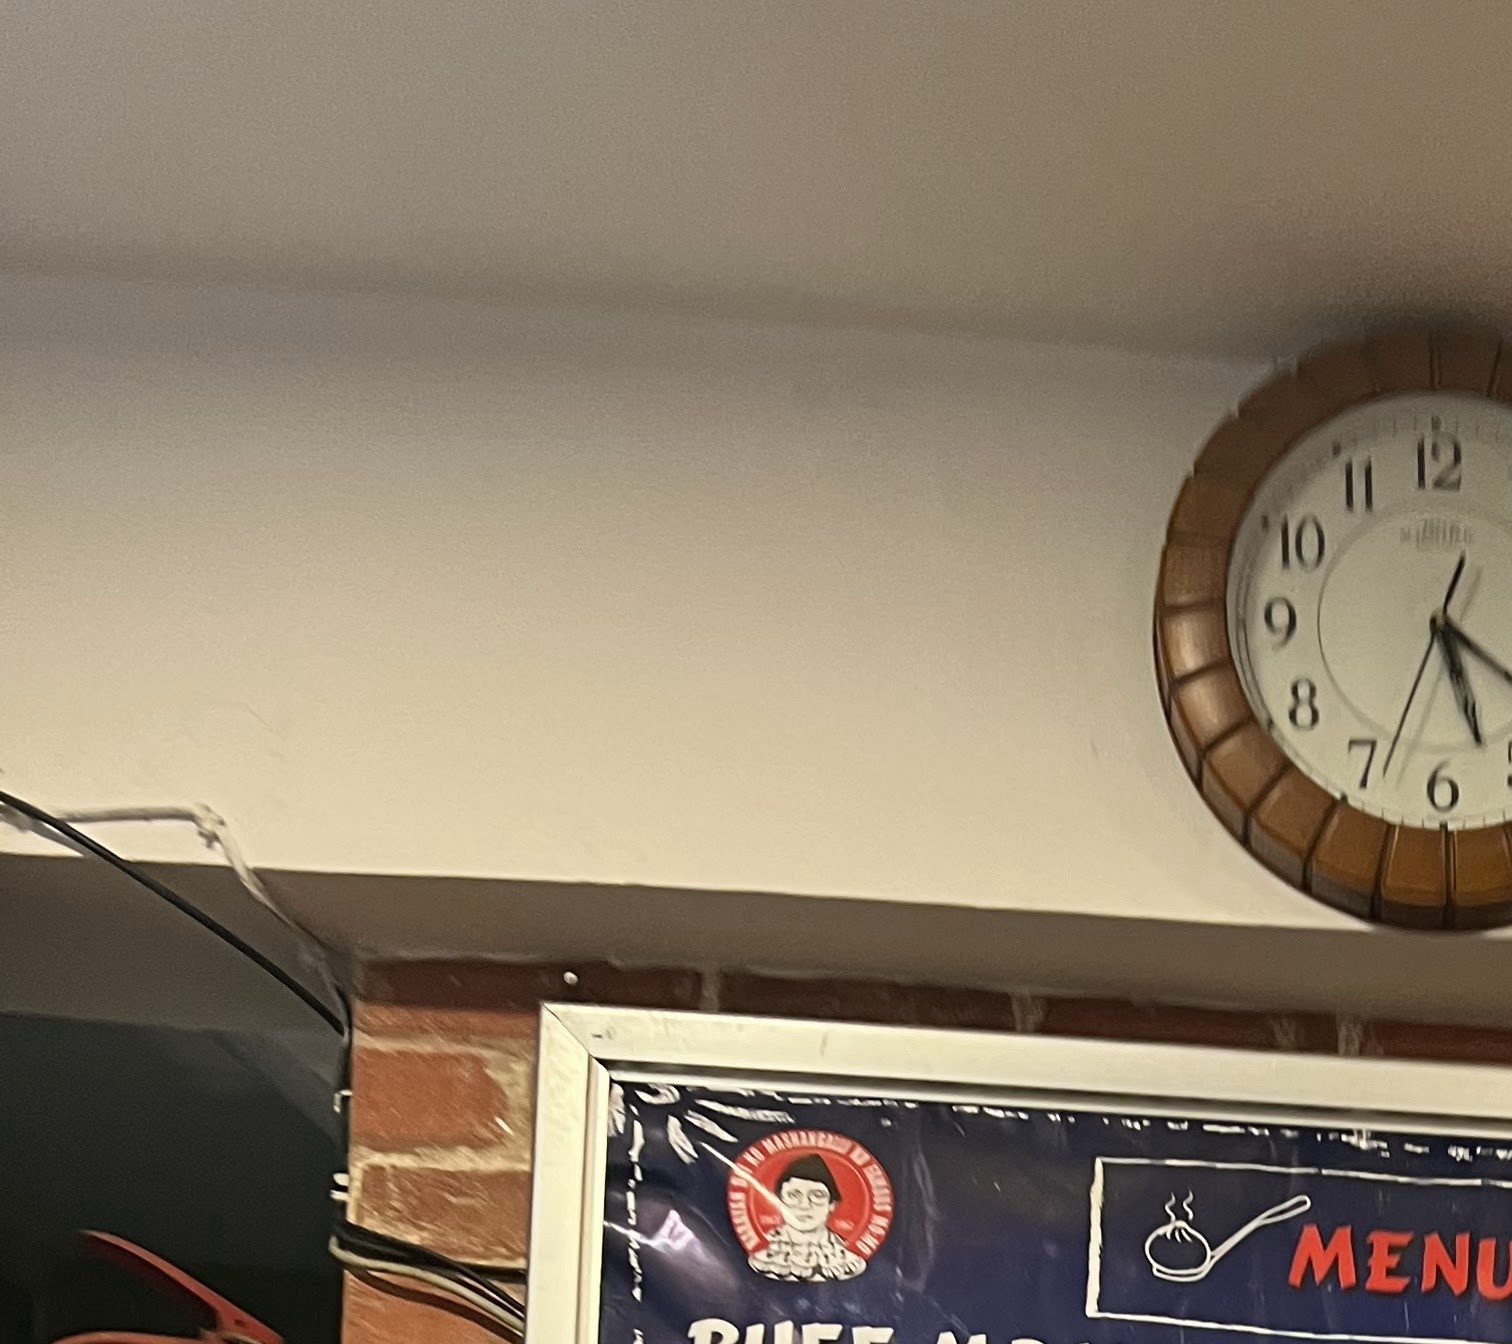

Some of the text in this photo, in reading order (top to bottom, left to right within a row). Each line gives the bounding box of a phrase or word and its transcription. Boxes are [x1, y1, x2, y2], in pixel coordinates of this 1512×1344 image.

[1344, 456, 1373, 514] 11
[1417, 433, 1462, 493] 12
[1280, 514, 1326, 572] 10
[1263, 597, 1298, 651] 9
[1288, 678, 1320, 731] 8
[1347, 738, 1378, 790] 7
[1426, 760, 1460, 814] 6
